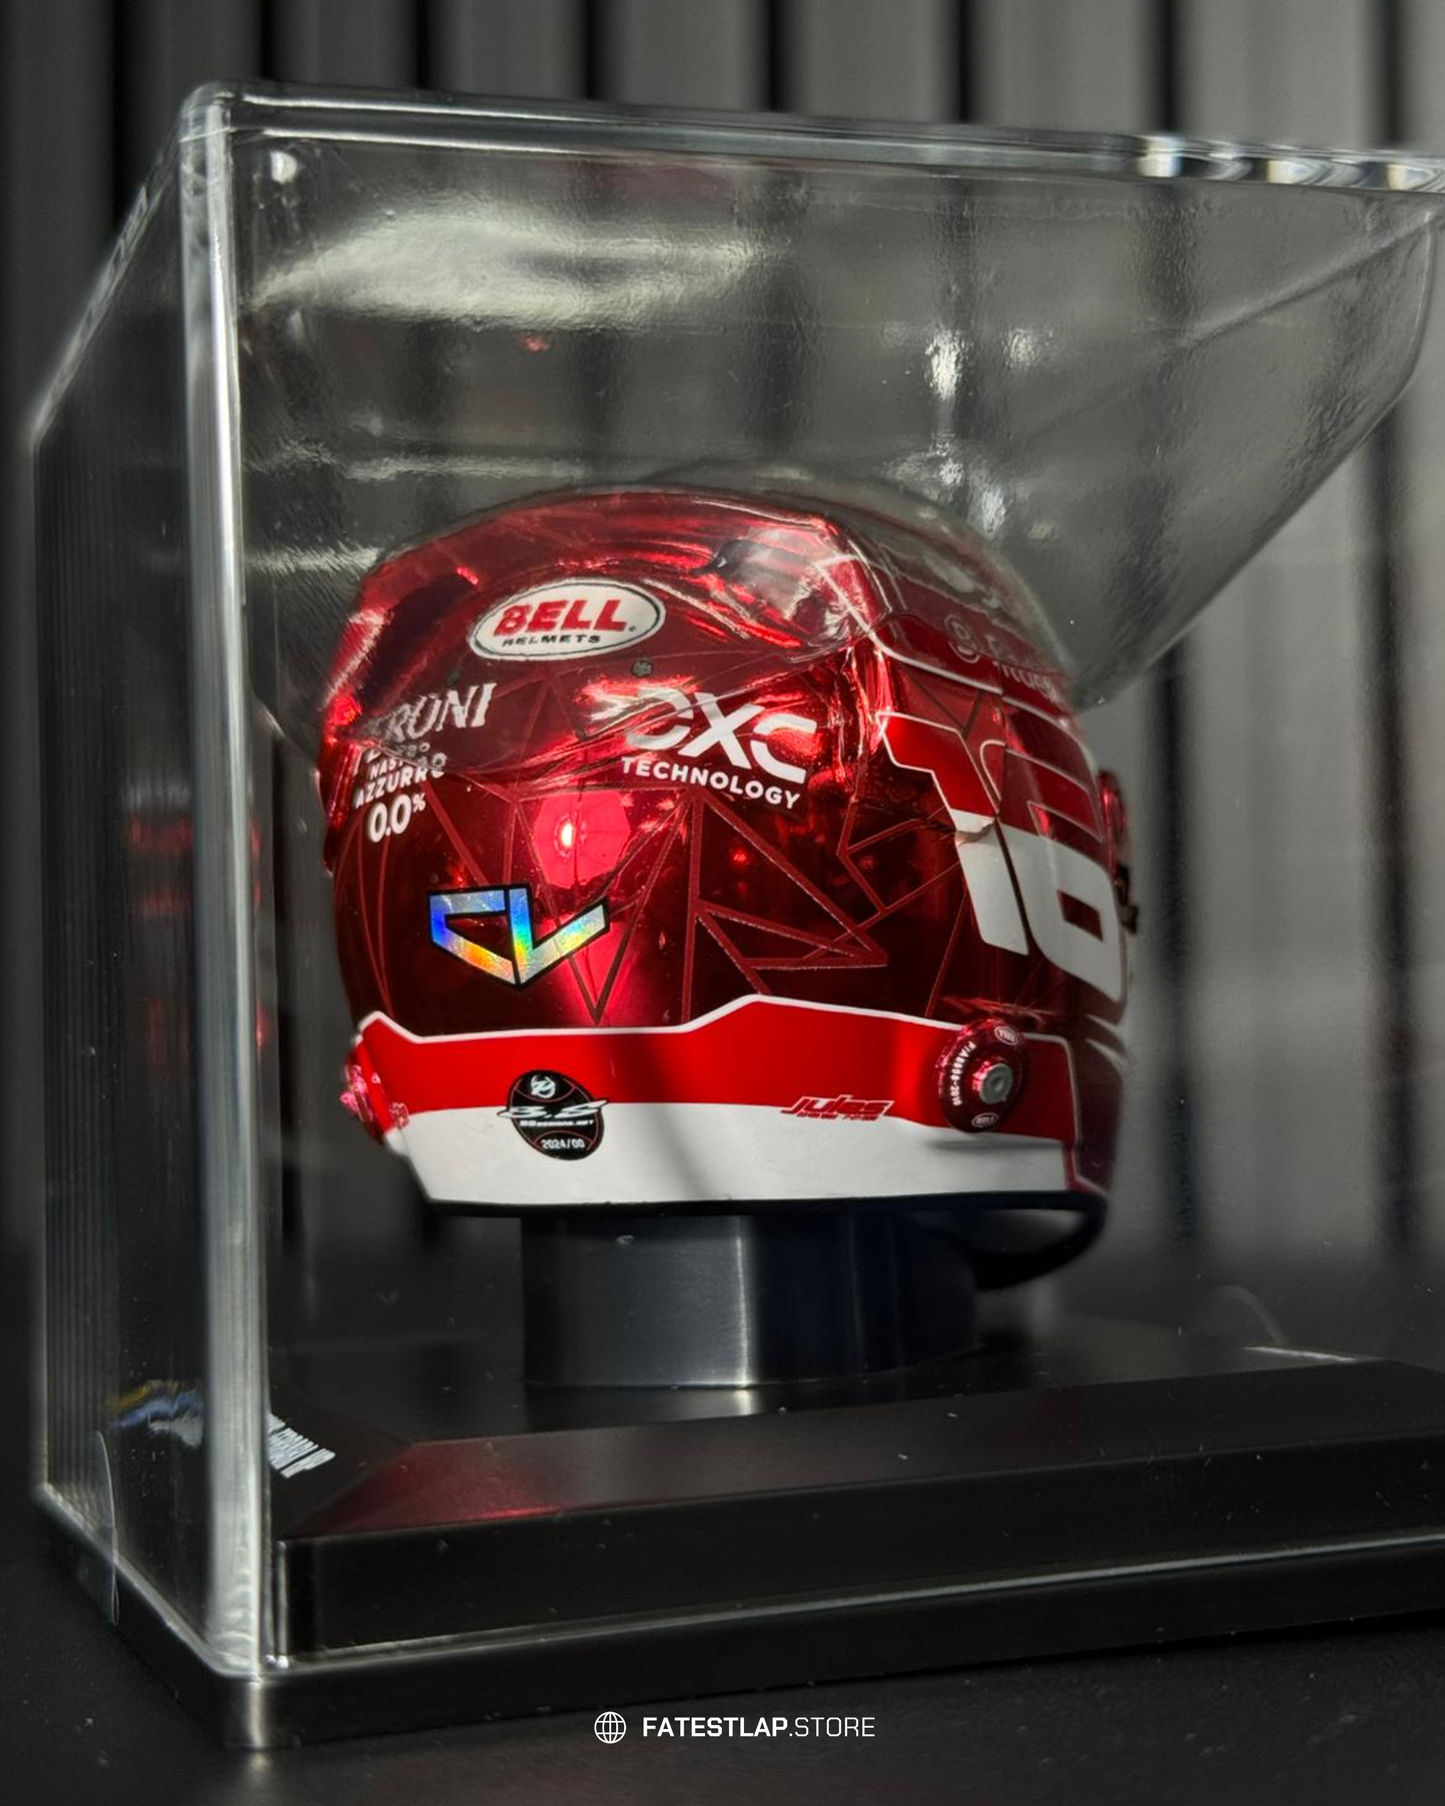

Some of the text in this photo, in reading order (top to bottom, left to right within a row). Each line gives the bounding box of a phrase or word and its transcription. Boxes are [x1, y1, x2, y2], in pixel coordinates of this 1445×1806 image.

[493, 600, 628, 637] BELL
[502, 634, 601, 647] HELMETS
[378, 682, 498, 743] RONI
[621, 757, 800, 809] TECHNOLOGY
[875, 711, 1122, 1003] 16
